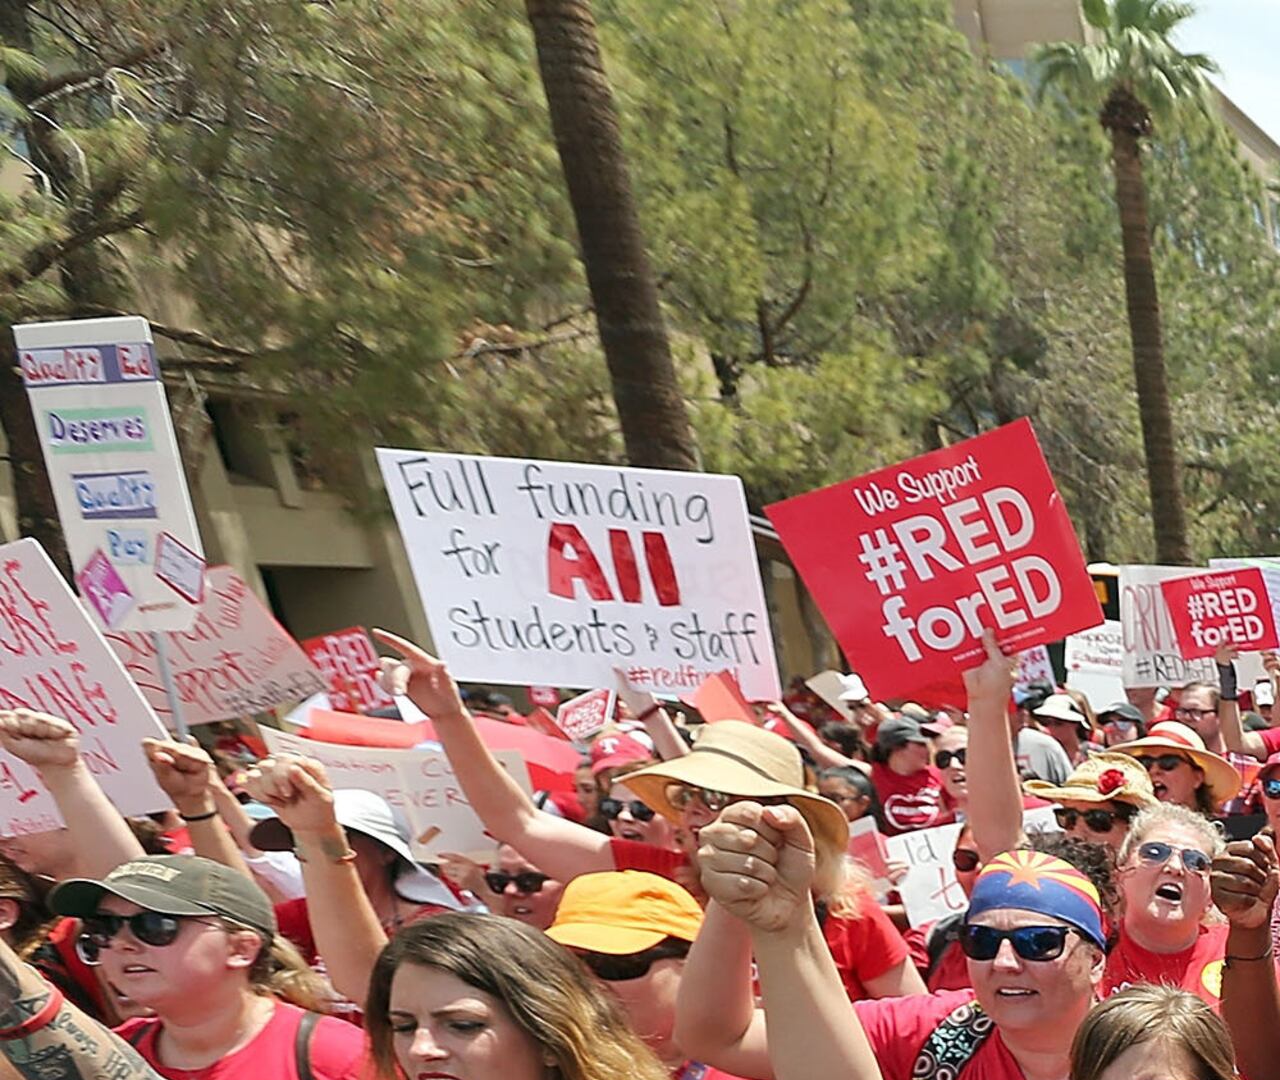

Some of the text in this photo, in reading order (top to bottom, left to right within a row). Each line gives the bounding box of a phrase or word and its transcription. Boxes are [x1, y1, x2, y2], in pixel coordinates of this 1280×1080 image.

[49, 411, 146, 442] Deserves
[397, 458, 714, 543] Full funding
[854, 455, 982, 516] We Support
[443, 522, 680, 606] for All
[858, 487, 1035, 595] #RED
[449, 600, 636, 656] Students
[670, 613, 760, 666] Staff
[882, 556, 1062, 663] forED
[1187, 587, 1258, 621] #RED
[1190, 615, 1264, 647] forED
